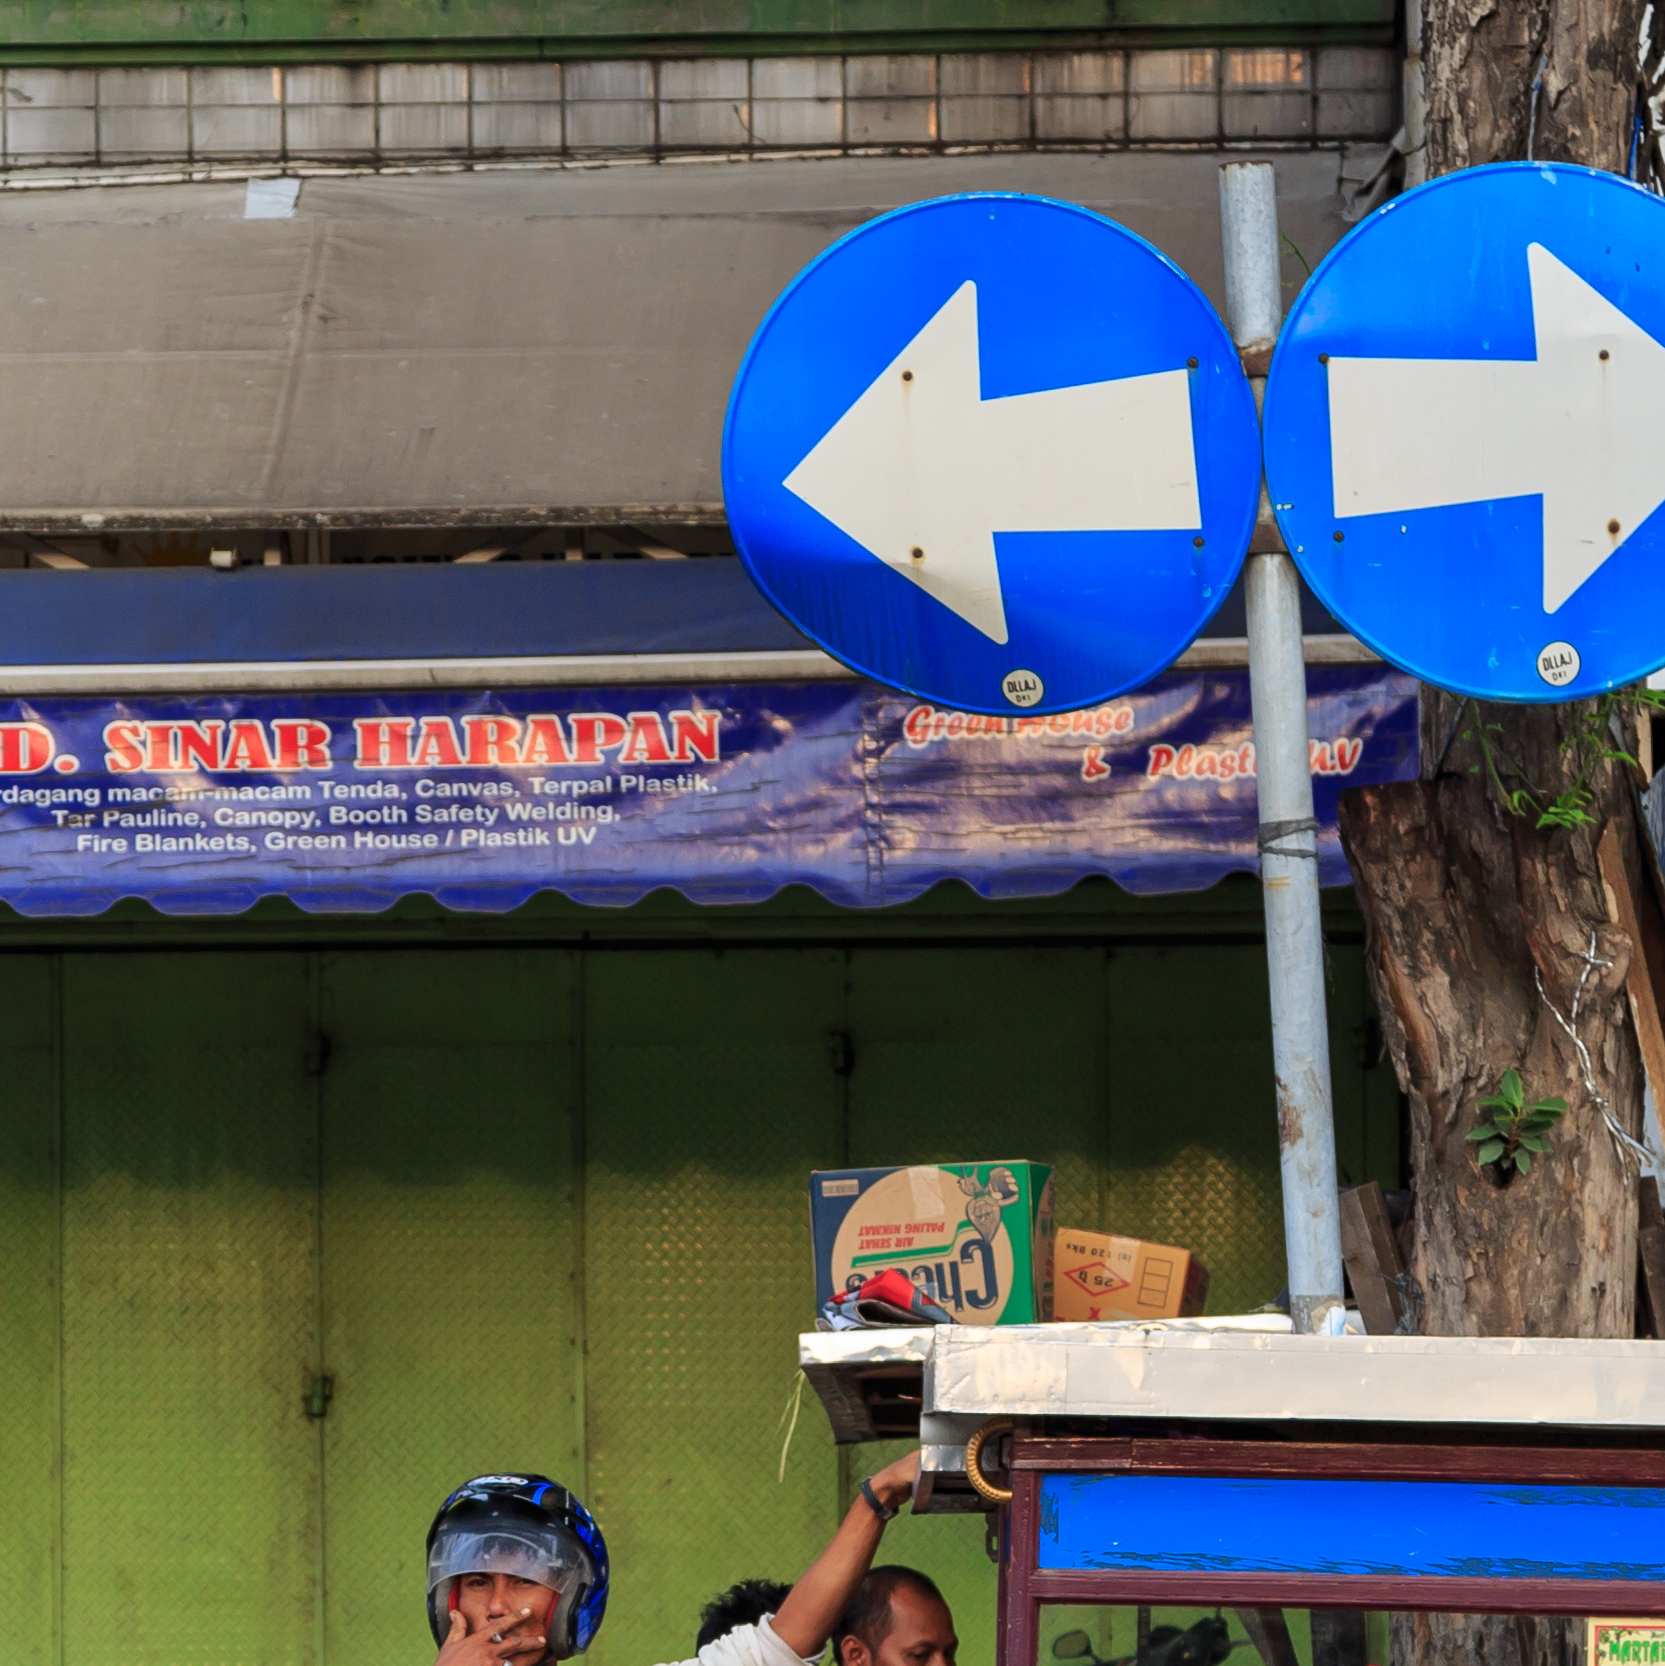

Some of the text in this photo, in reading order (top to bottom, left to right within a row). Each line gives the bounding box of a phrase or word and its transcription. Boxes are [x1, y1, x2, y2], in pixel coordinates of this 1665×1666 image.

[103, 718, 332, 773] SINAR
[353, 710, 721, 769] HARAPAN
[903, 704, 1008, 748] Green
[1081, 745, 1111, 782] &
[108, 783, 311, 803] macam-macam
[319, 780, 408, 801] Tenda,
[415, 778, 521, 800] Canvas,
[528, 775, 612, 800] Terpal
[621, 773, 718, 796] Plastik,
[51, 801, 622, 831] Tar Pauline, Canopy, Booth Safety Welding,
[77, 834, 127, 853] Fire
[135, 832, 258, 855] Blankets,
[263, 830, 347, 852] Green
[353, 829, 439, 850] House
[460, 827, 550, 847] Plastik
[557, 826, 598, 846] UV
